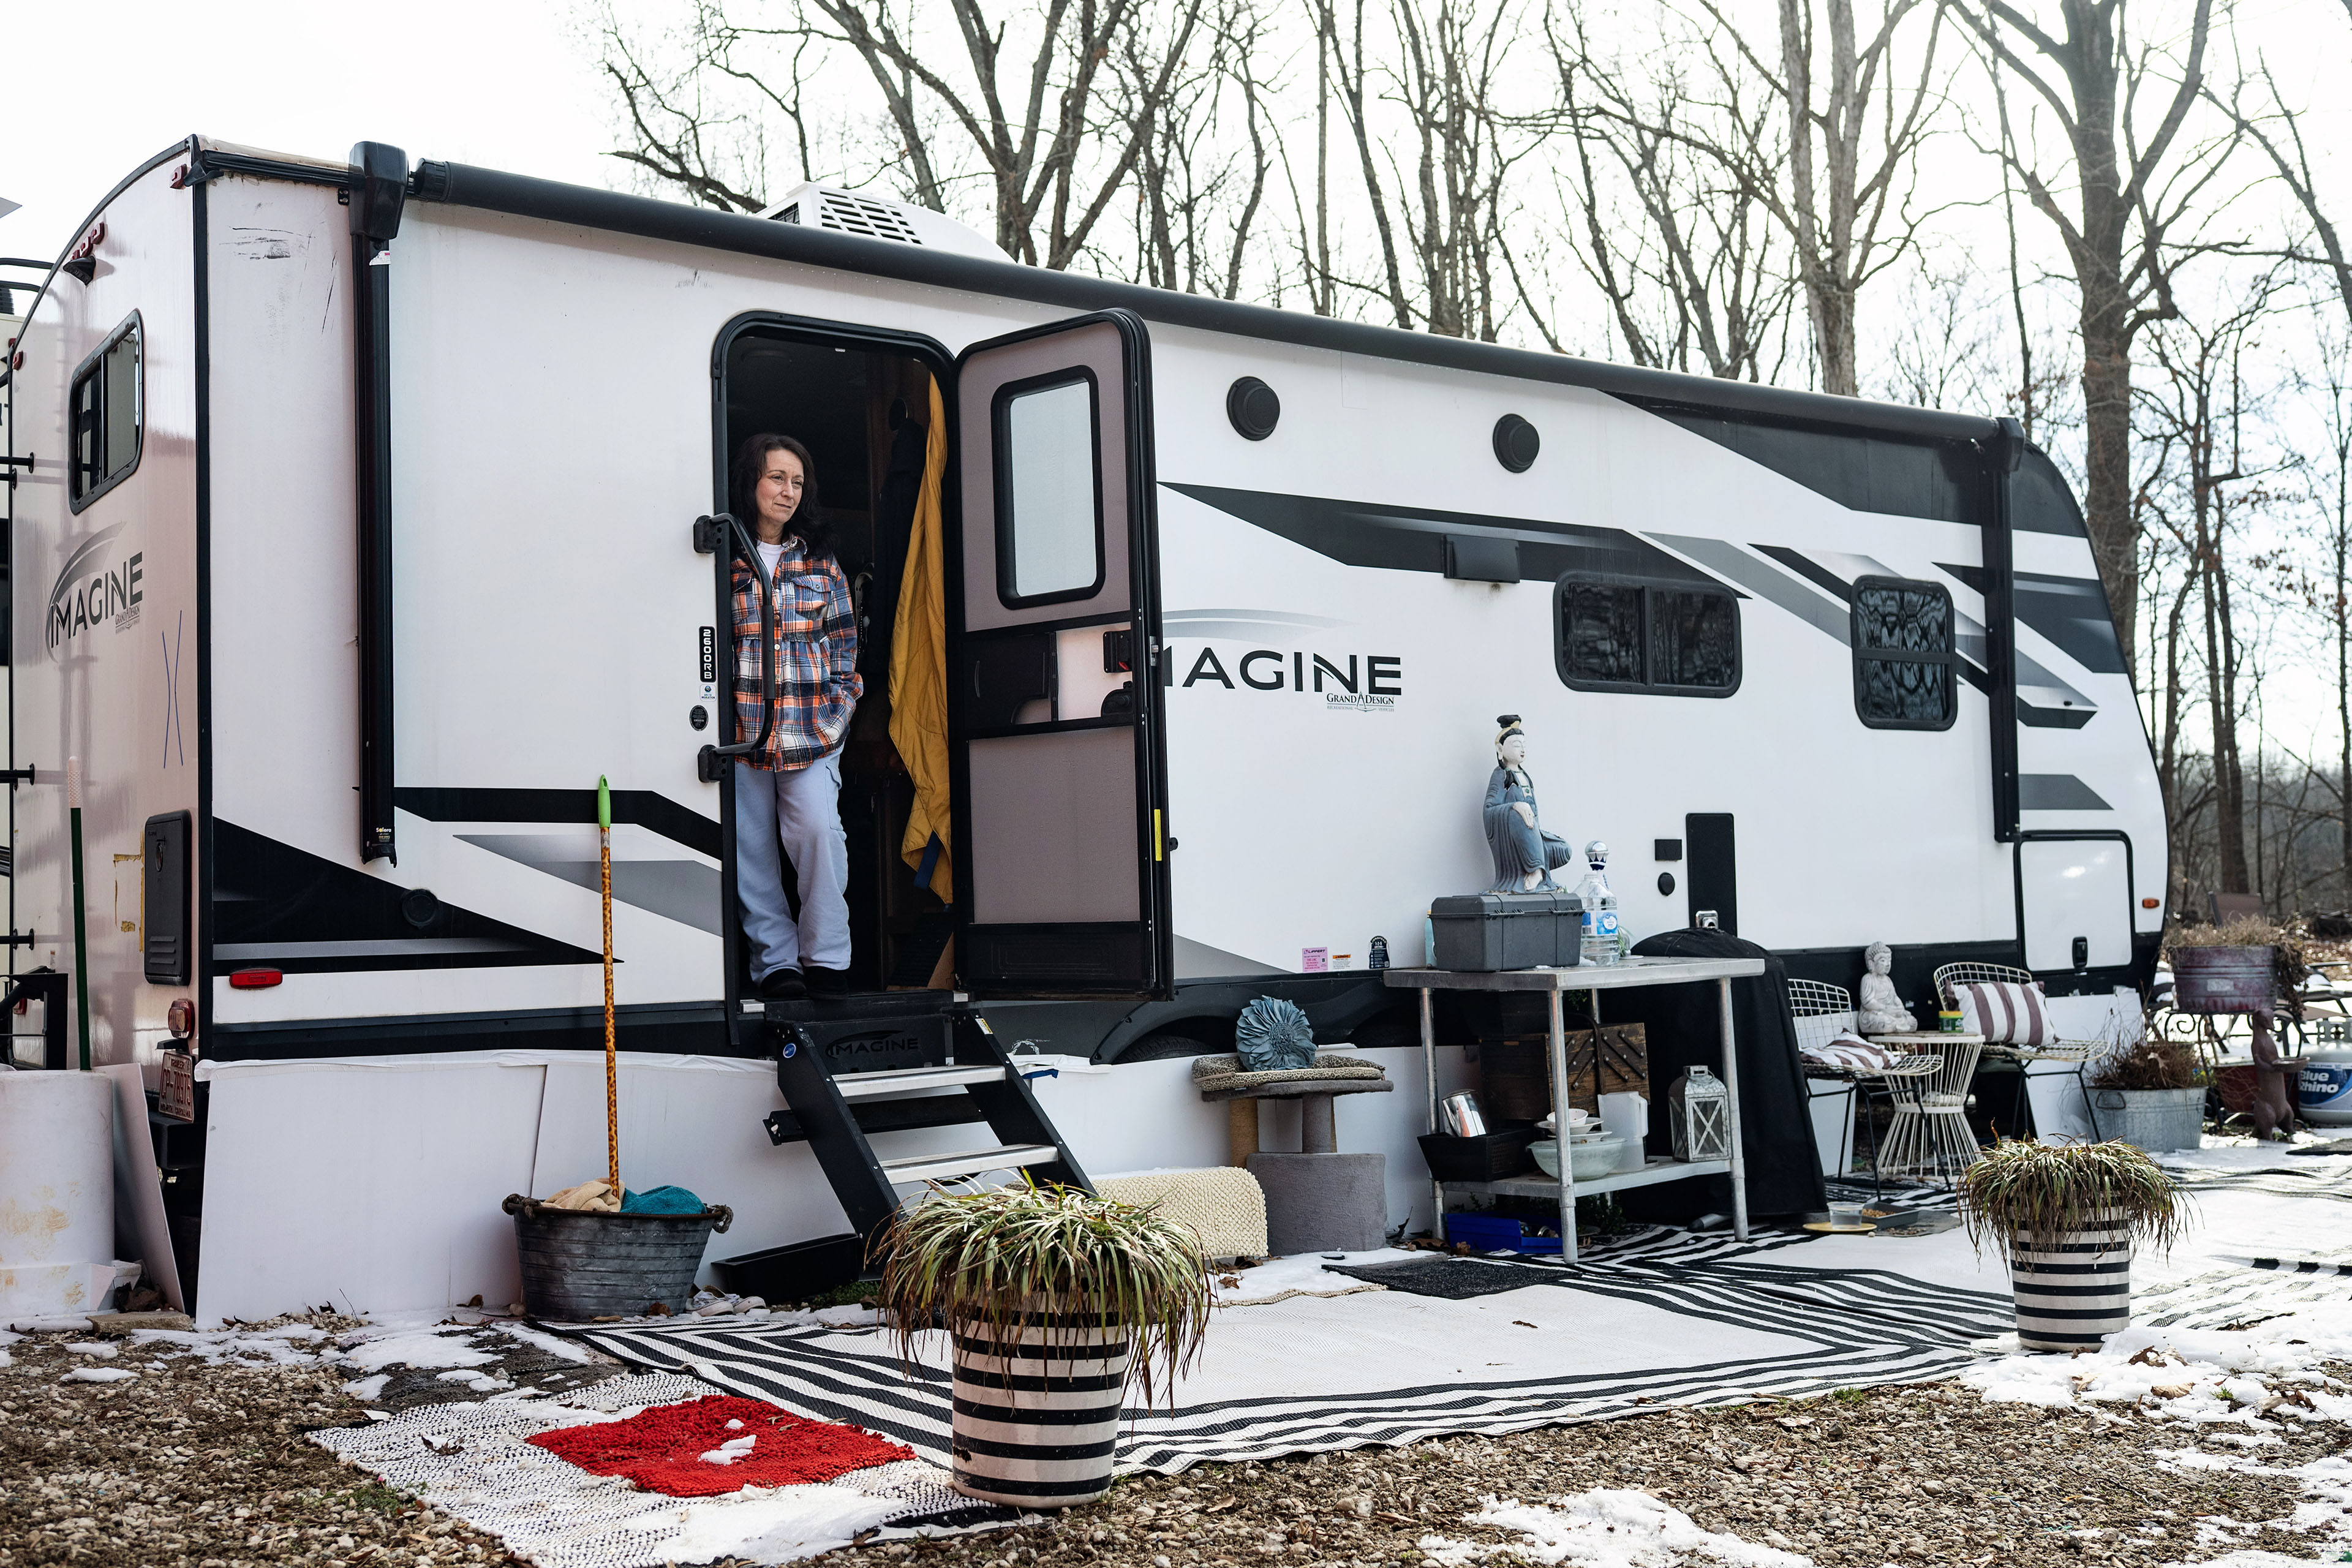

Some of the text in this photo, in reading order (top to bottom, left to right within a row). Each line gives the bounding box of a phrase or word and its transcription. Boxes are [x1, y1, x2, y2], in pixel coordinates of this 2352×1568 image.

[51, 551, 143, 649] IMAGINE
[703, 628, 713, 680] 2600RB
[1163, 646, 1402, 696] AGINE
[1326, 693, 1395, 705] GRAND DESIGN
[830, 1038, 919, 1056] IMAGINE
